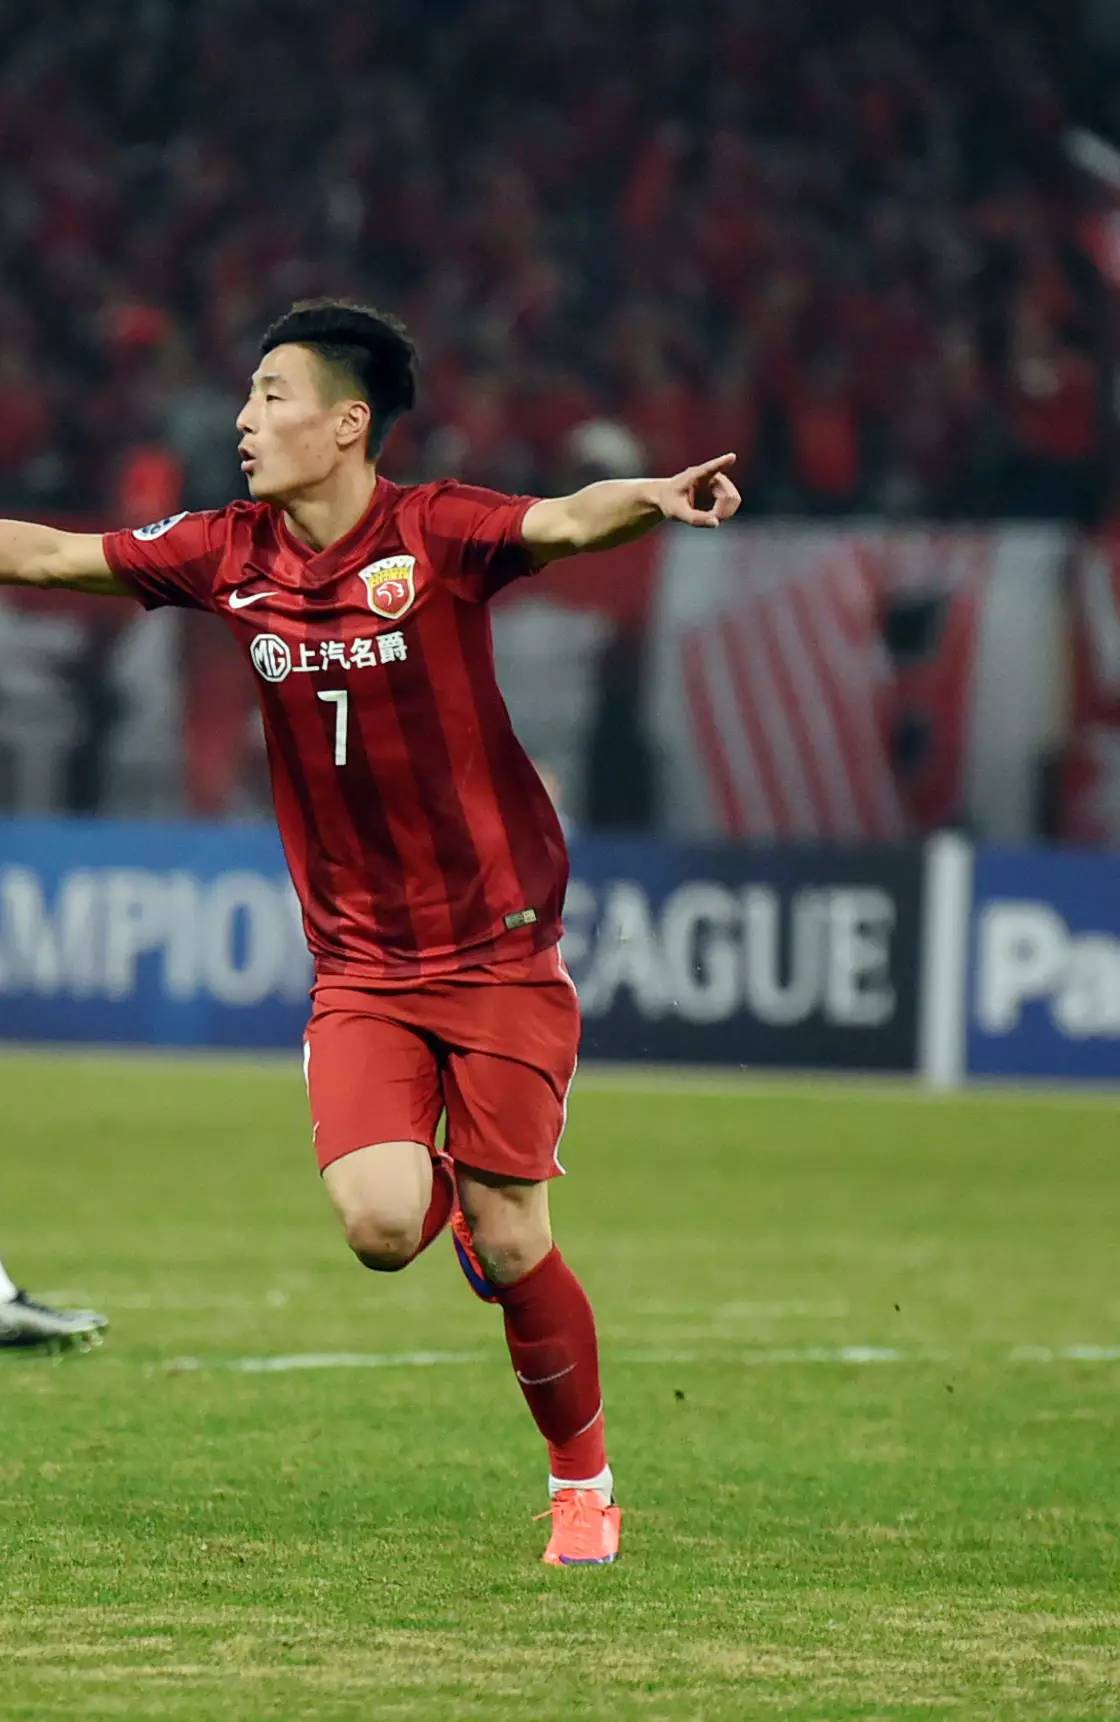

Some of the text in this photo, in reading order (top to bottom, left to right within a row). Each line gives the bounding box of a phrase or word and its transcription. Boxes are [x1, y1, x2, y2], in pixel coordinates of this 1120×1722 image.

[251, 631, 408, 679] MG 上汽名爵
[317, 689, 348, 766] 7
